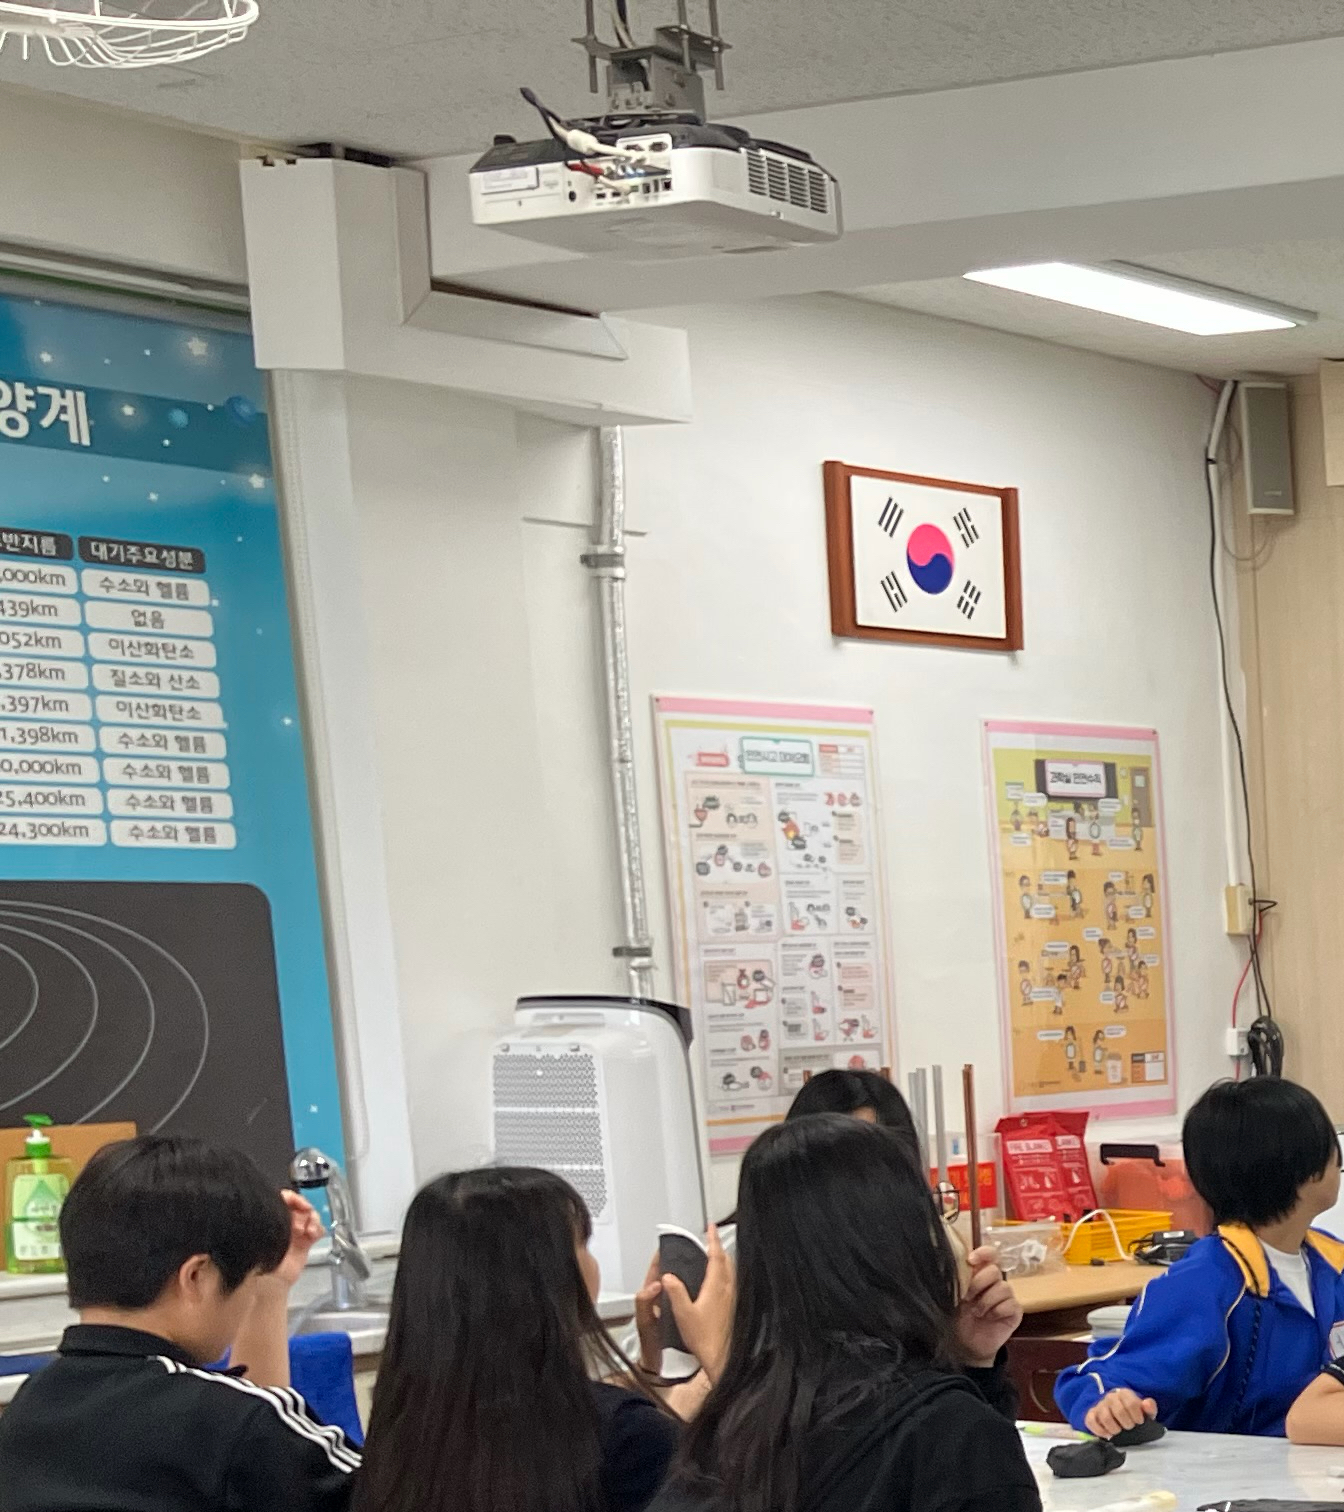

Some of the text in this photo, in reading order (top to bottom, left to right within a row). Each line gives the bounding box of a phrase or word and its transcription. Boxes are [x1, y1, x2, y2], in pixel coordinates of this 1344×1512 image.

[0, 380, 91, 447] 양계
[0, 531, 195, 571] 반지름 대기주요성분
[99, 576, 150, 597] 수소와
[108, 638, 195, 661] 이산화탄소
[110, 668, 161, 690] 질소와
[169, 673, 201, 691] 산소
[116, 701, 202, 721] 이산화탄소
[118, 732, 168, 751] 수소와
[122, 763, 172, 782] 수소와
[126, 793, 175, 812] 수소와
[129, 824, 178, 843] 수소와
